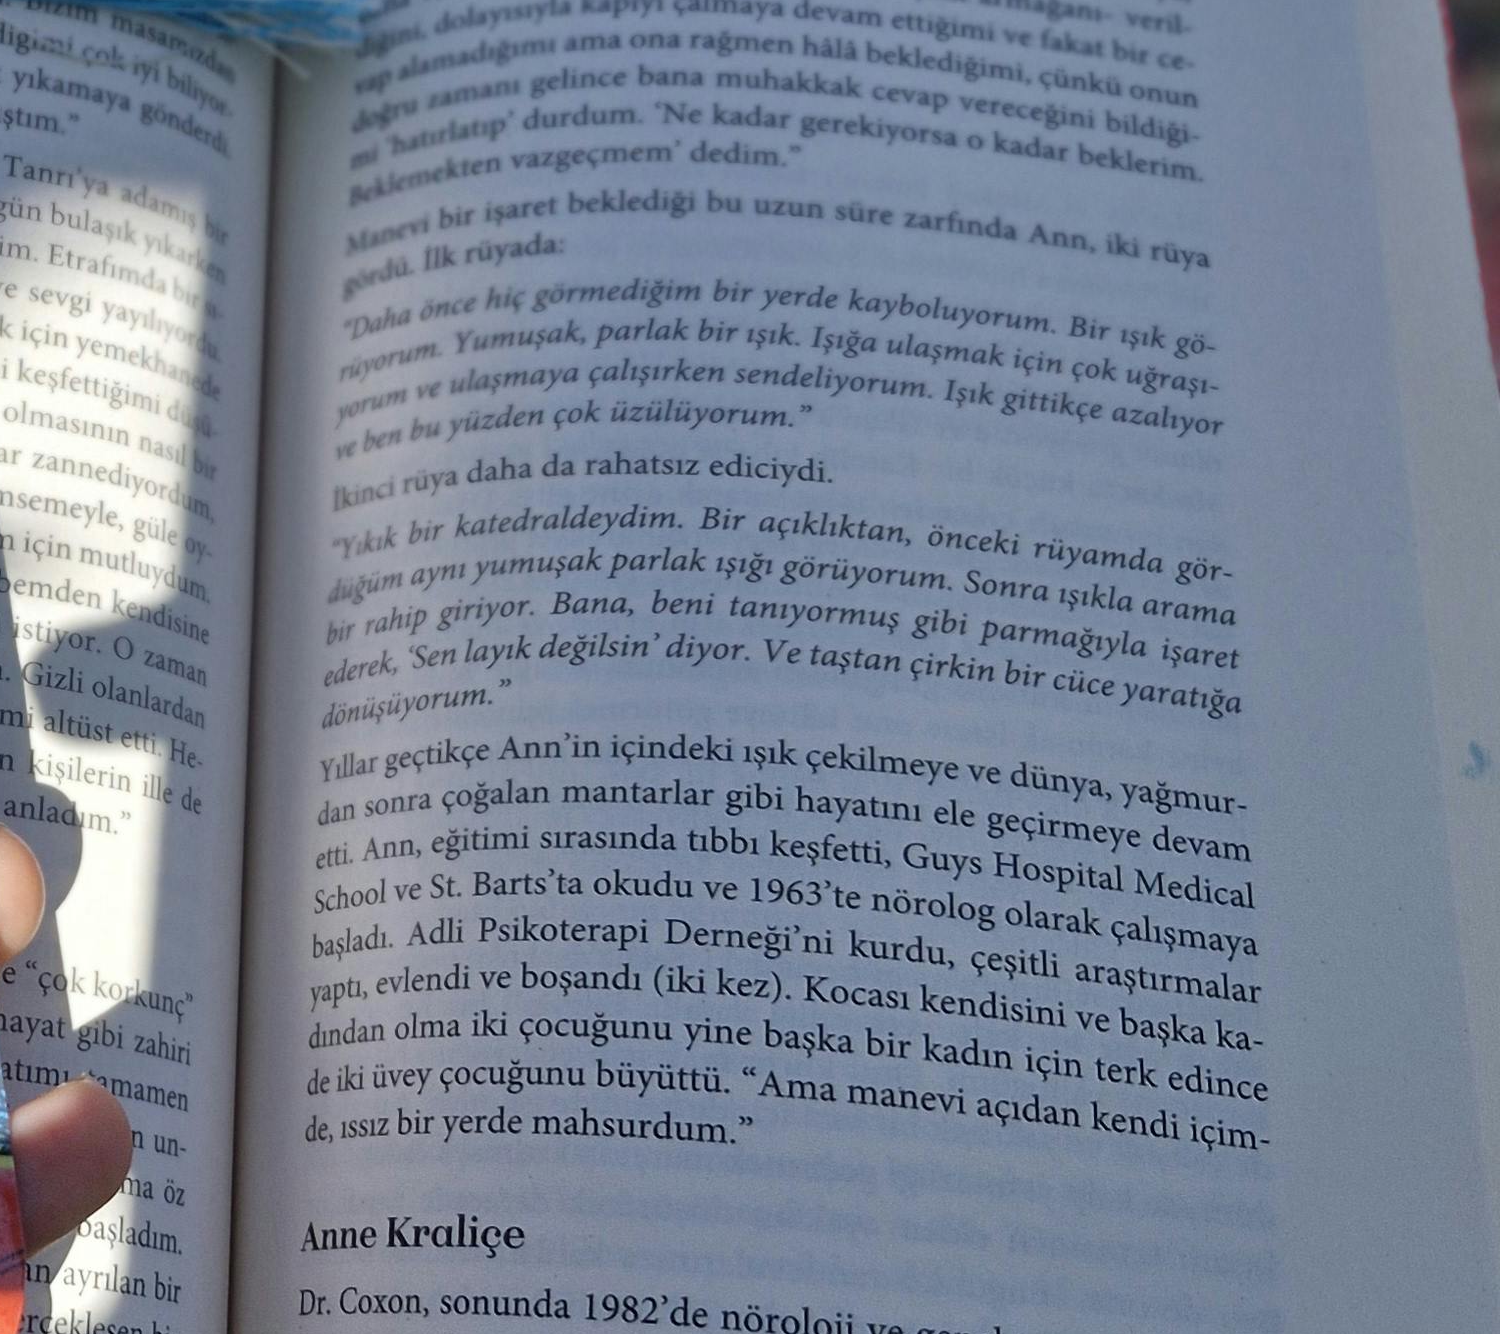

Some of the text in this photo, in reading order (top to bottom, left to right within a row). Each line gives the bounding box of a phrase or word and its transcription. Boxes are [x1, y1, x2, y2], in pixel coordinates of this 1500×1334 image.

[12, 68, 131, 112] yıkamaya
[348, 157, 502, 205] Beklemekten
[346, 188, 1212, 272] Manevi bir işaret beklediği bu uzun süre zarfında Ann, iki rüya
[29, 283, 93, 316] sevgi
[17, 359, 160, 414] keşfettiğimi
[4, 400, 187, 467] olmasının nasıl
[334, 451, 833, 511] İkinci rüya daha da rahatsız ediciydi.
[134, 514, 178, 547] güle
[22, 531, 210, 603] için mutluydum.
[328, 546, 1236, 626] düğüm aynı yumuşak parlak ışığı görüyorum. Sonra ışıkla arama
[112, 590, 210, 645] kendisine
[13, 617, 207, 687] istiyor. O zaman
[21, 662, 205, 729] Gizli olanlardan
[43, 709, 202, 769] altüst etti. He-
[29, 749, 202, 814] kişilerin ille de
[320, 752, 379, 782] Yıllar
[384, 738, 490, 779] geçtikçe
[610, 733, 734, 766] içindeki
[742, 739, 798, 771] ışık
[806, 743, 959, 786] çekilmeye
[966, 764, 1001, 784] ve
[1010, 761, 1115, 803] dünya,
[1119, 780, 1247, 815] yağmur-
[316, 823, 1256, 910] etti. Ann, eğitimi sırasında tıbbı keşfetti, Guys Hospital Medical
[313, 923, 393, 962] başladı.
[406, 917, 463, 946] Adli
[478, 915, 649, 951] Psikoterapi
[849, 929, 955, 970] kurdu,
[971, 949, 1060, 981] çeşitli
[1075, 963, 1262, 1004] araştırmalar
[77, 1023, 191, 1066] gibi zahiri
[154, 1132, 187, 1157] un-
[305, 1115, 333, 1143] de,
[341, 1118, 390, 1139] ıssız
[398, 1107, 435, 1135] bir
[442, 1105, 523, 1143] yerde
[164, 1180, 185, 1206] öz
[300, 1213, 525, 1259] Anne Kraliçe
[64, 1266, 182, 1304] ayrılan bir
[299, 1289, 331, 1316] Dr.
[340, 1287, 430, 1320] Coxon,
[440, 1288, 571, 1319] sonunda
